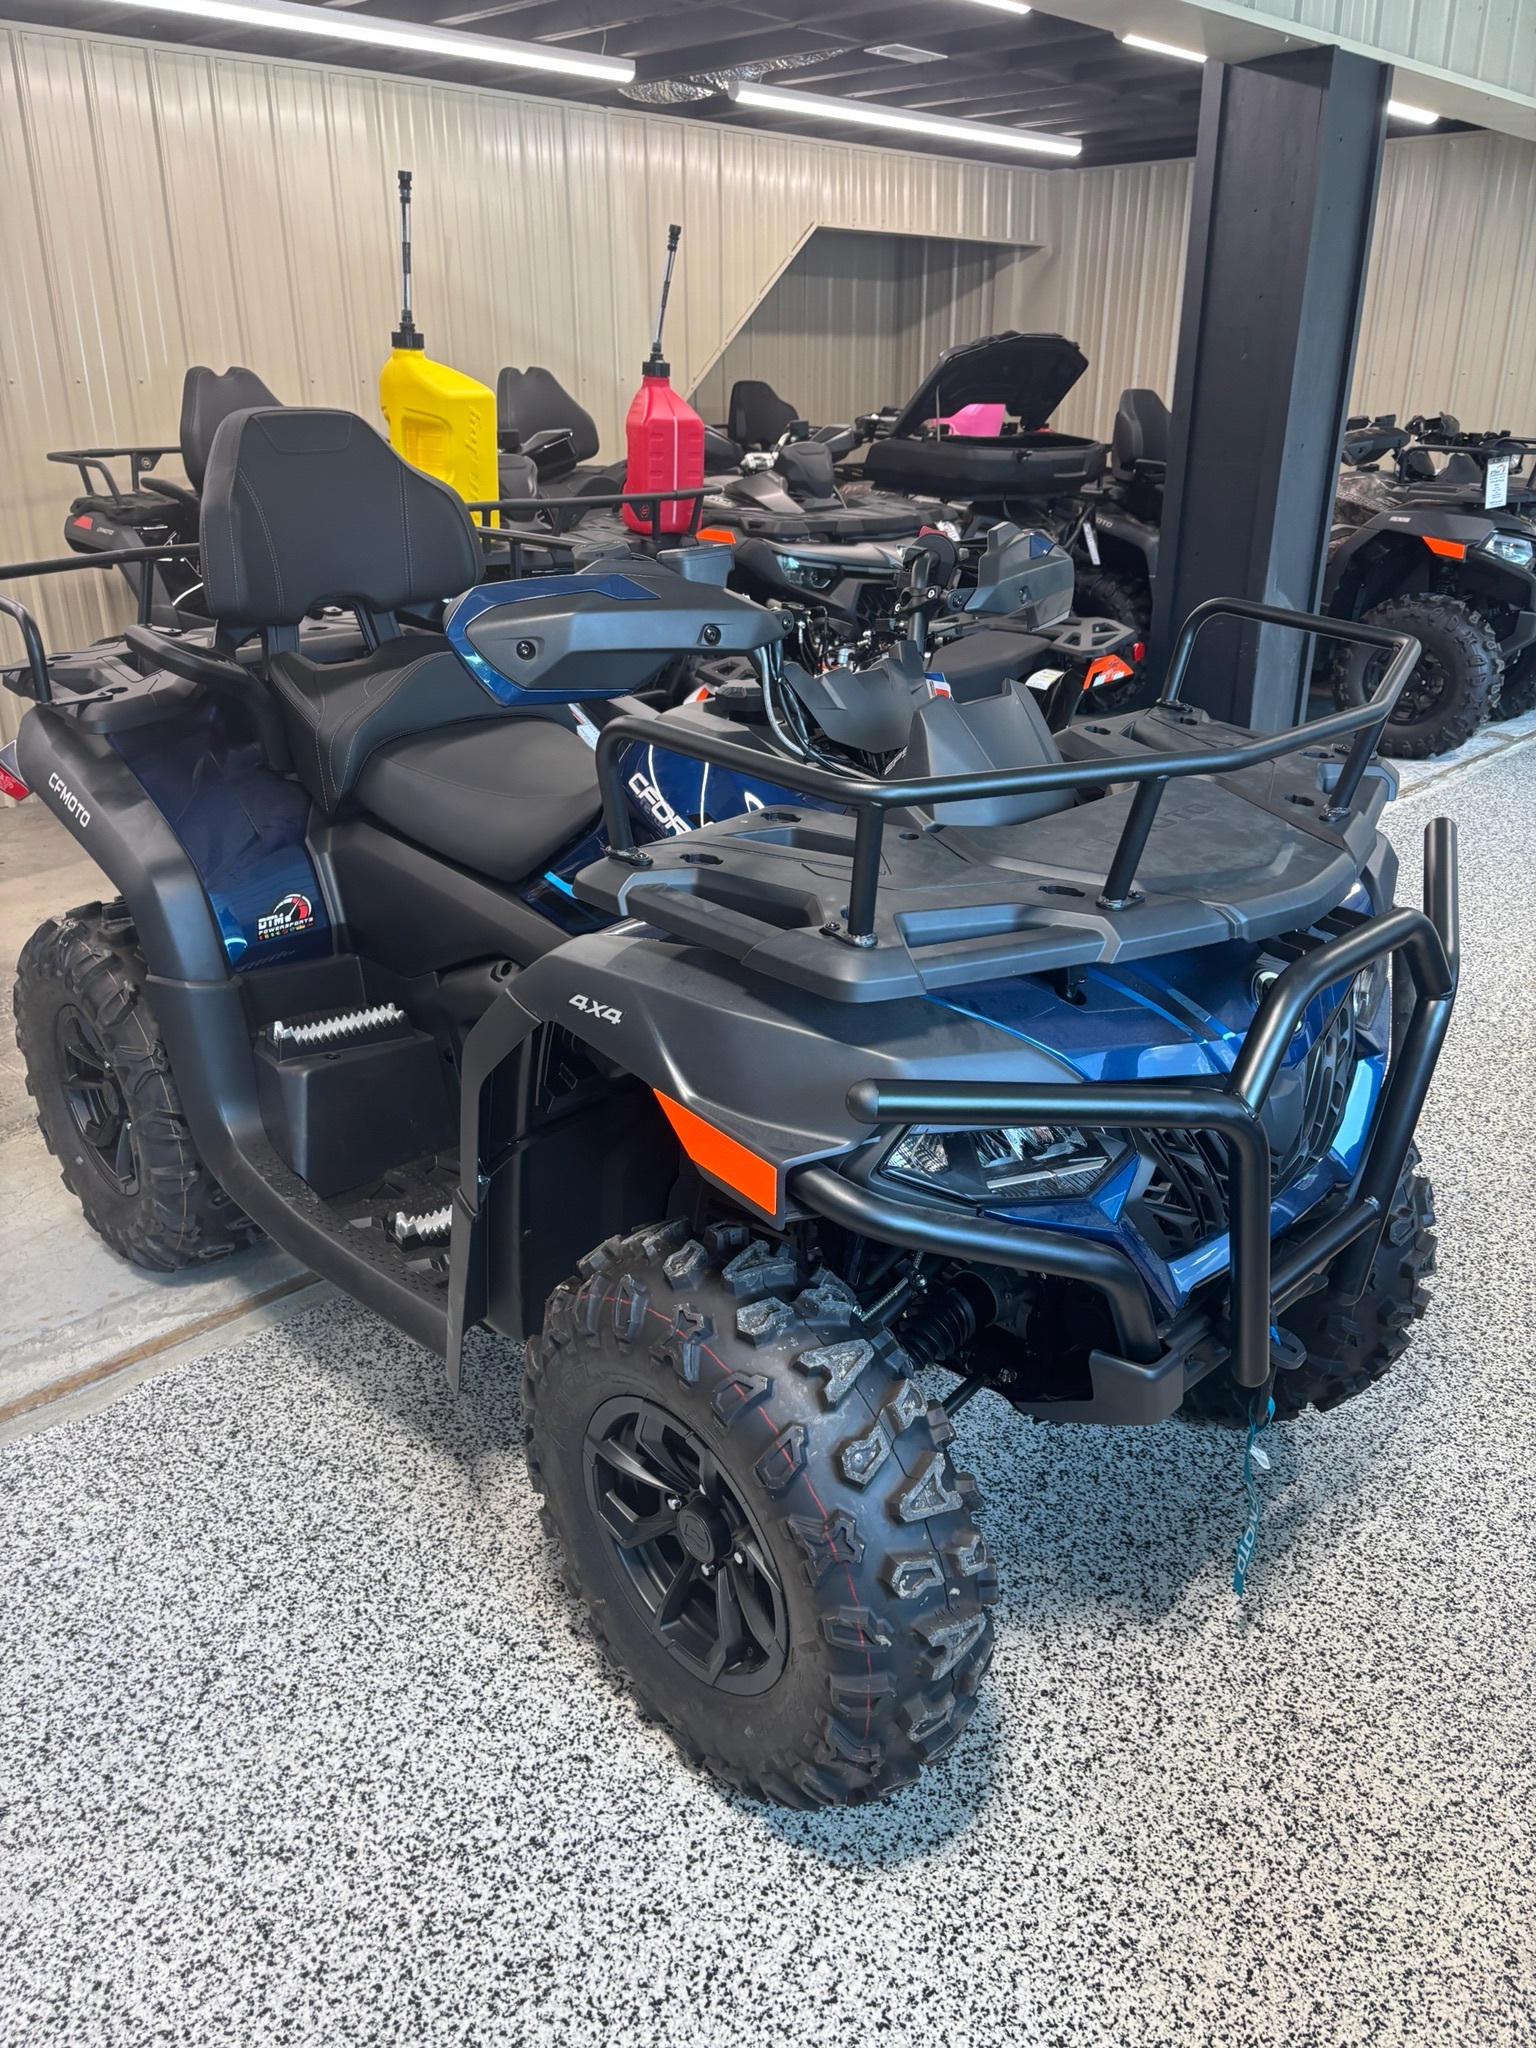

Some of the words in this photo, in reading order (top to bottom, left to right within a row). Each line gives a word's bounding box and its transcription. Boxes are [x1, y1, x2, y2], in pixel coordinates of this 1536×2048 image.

[1096, 517, 1113, 528] OTO
[48, 771, 91, 828] CFMOTO
[628, 772, 692, 836] CFOR
[258, 912, 285, 931] DTM
[258, 917, 314, 936] POWERSPORTS
